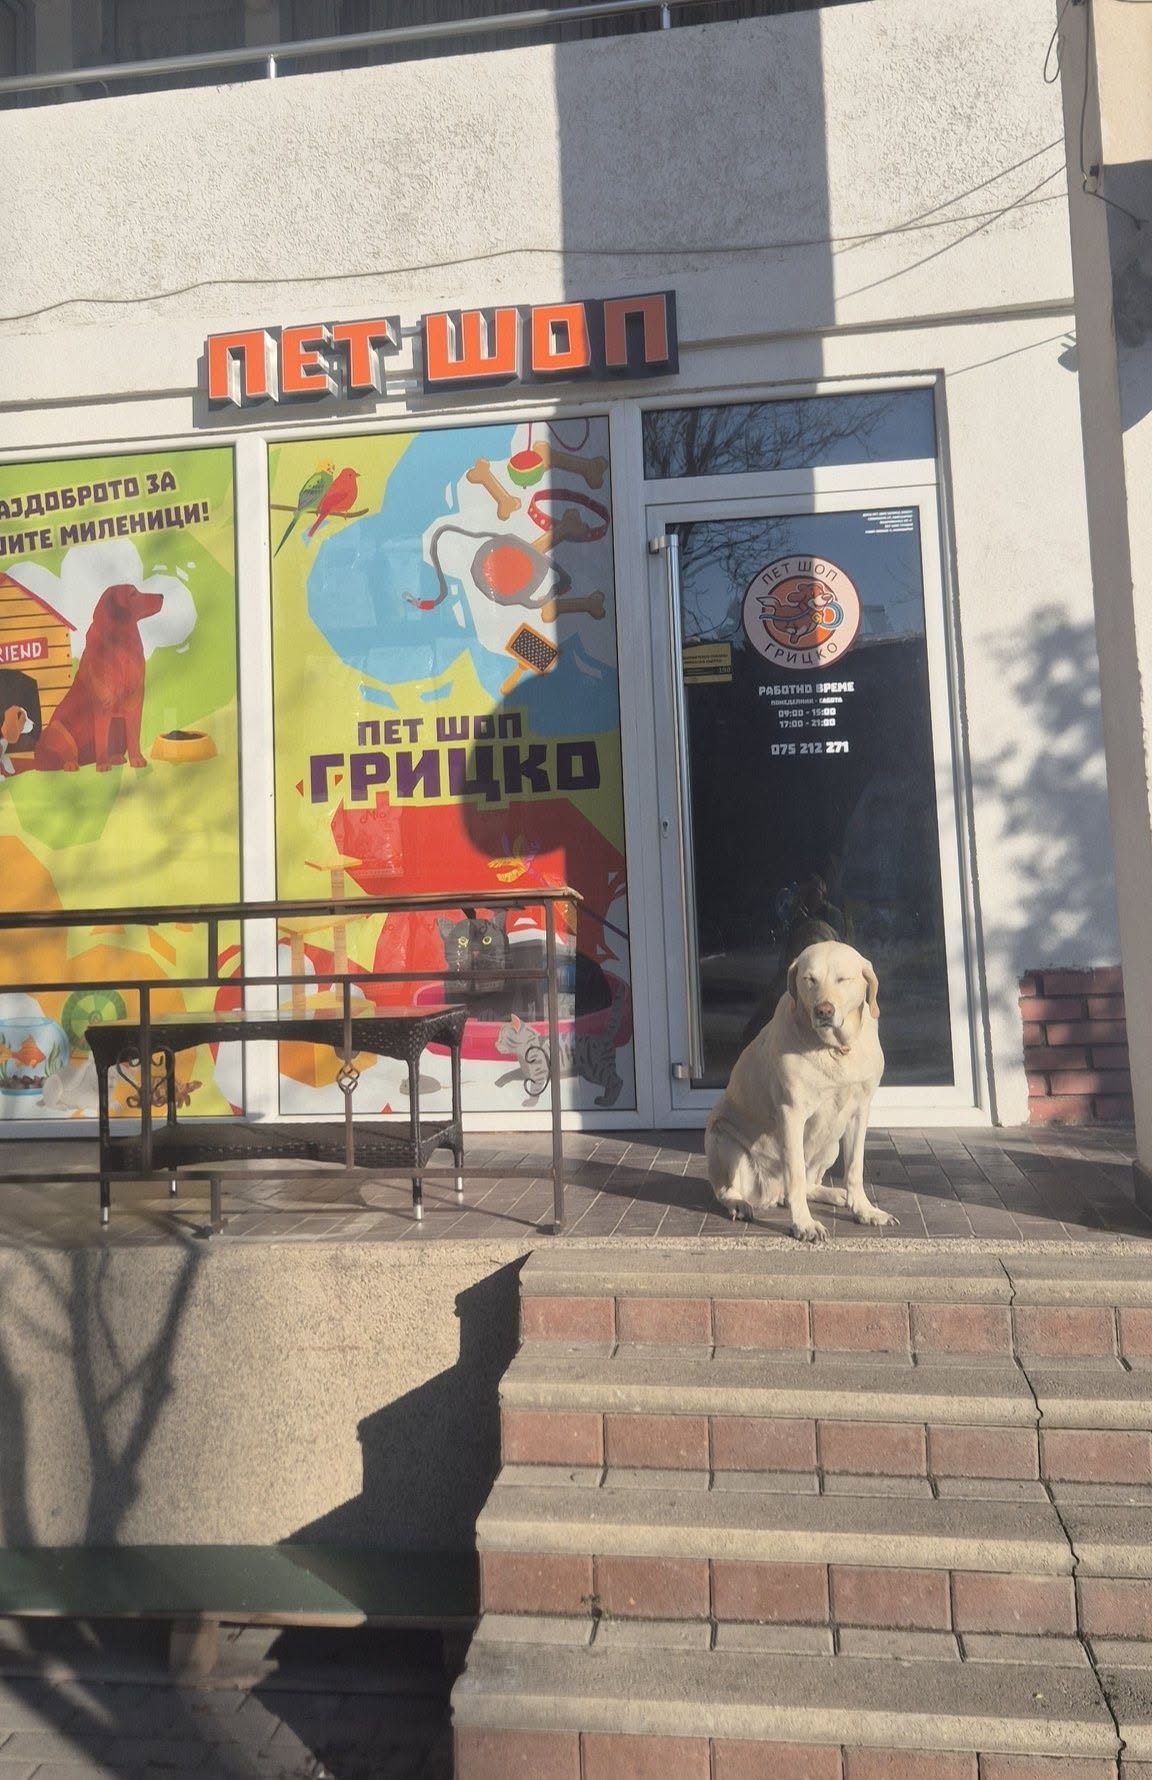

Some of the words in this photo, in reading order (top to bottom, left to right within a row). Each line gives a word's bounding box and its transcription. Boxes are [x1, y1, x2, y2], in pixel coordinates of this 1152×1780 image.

[208, 317, 399, 404] ПЕТ
[425, 294, 670, 384] ШОП
[146, 471, 177, 495] ЗА
[60, 501, 210, 546] МИЛЕНИЦИ!
[761, 563, 790, 585] ПЕТ
[798, 561, 838, 581] ШОП
[764, 643, 838, 664] ГРИЦКО
[759, 683, 813, 696] РАБОТНО
[815, 681, 855, 694] ВРЕМЕ
[778, 709, 804, 718] 09:00
[811, 707, 837, 717] 15:00
[779, 720, 804, 729] 17:00
[811, 718, 836, 727] 21:00
[357, 718, 424, 746] ПЕТ
[436, 712, 523, 742] ШОП
[771, 743, 796, 756] 075
[800, 742, 823, 755] 212
[826, 740, 850, 754] 271
[310, 741, 600, 804] ГРИЦКО
